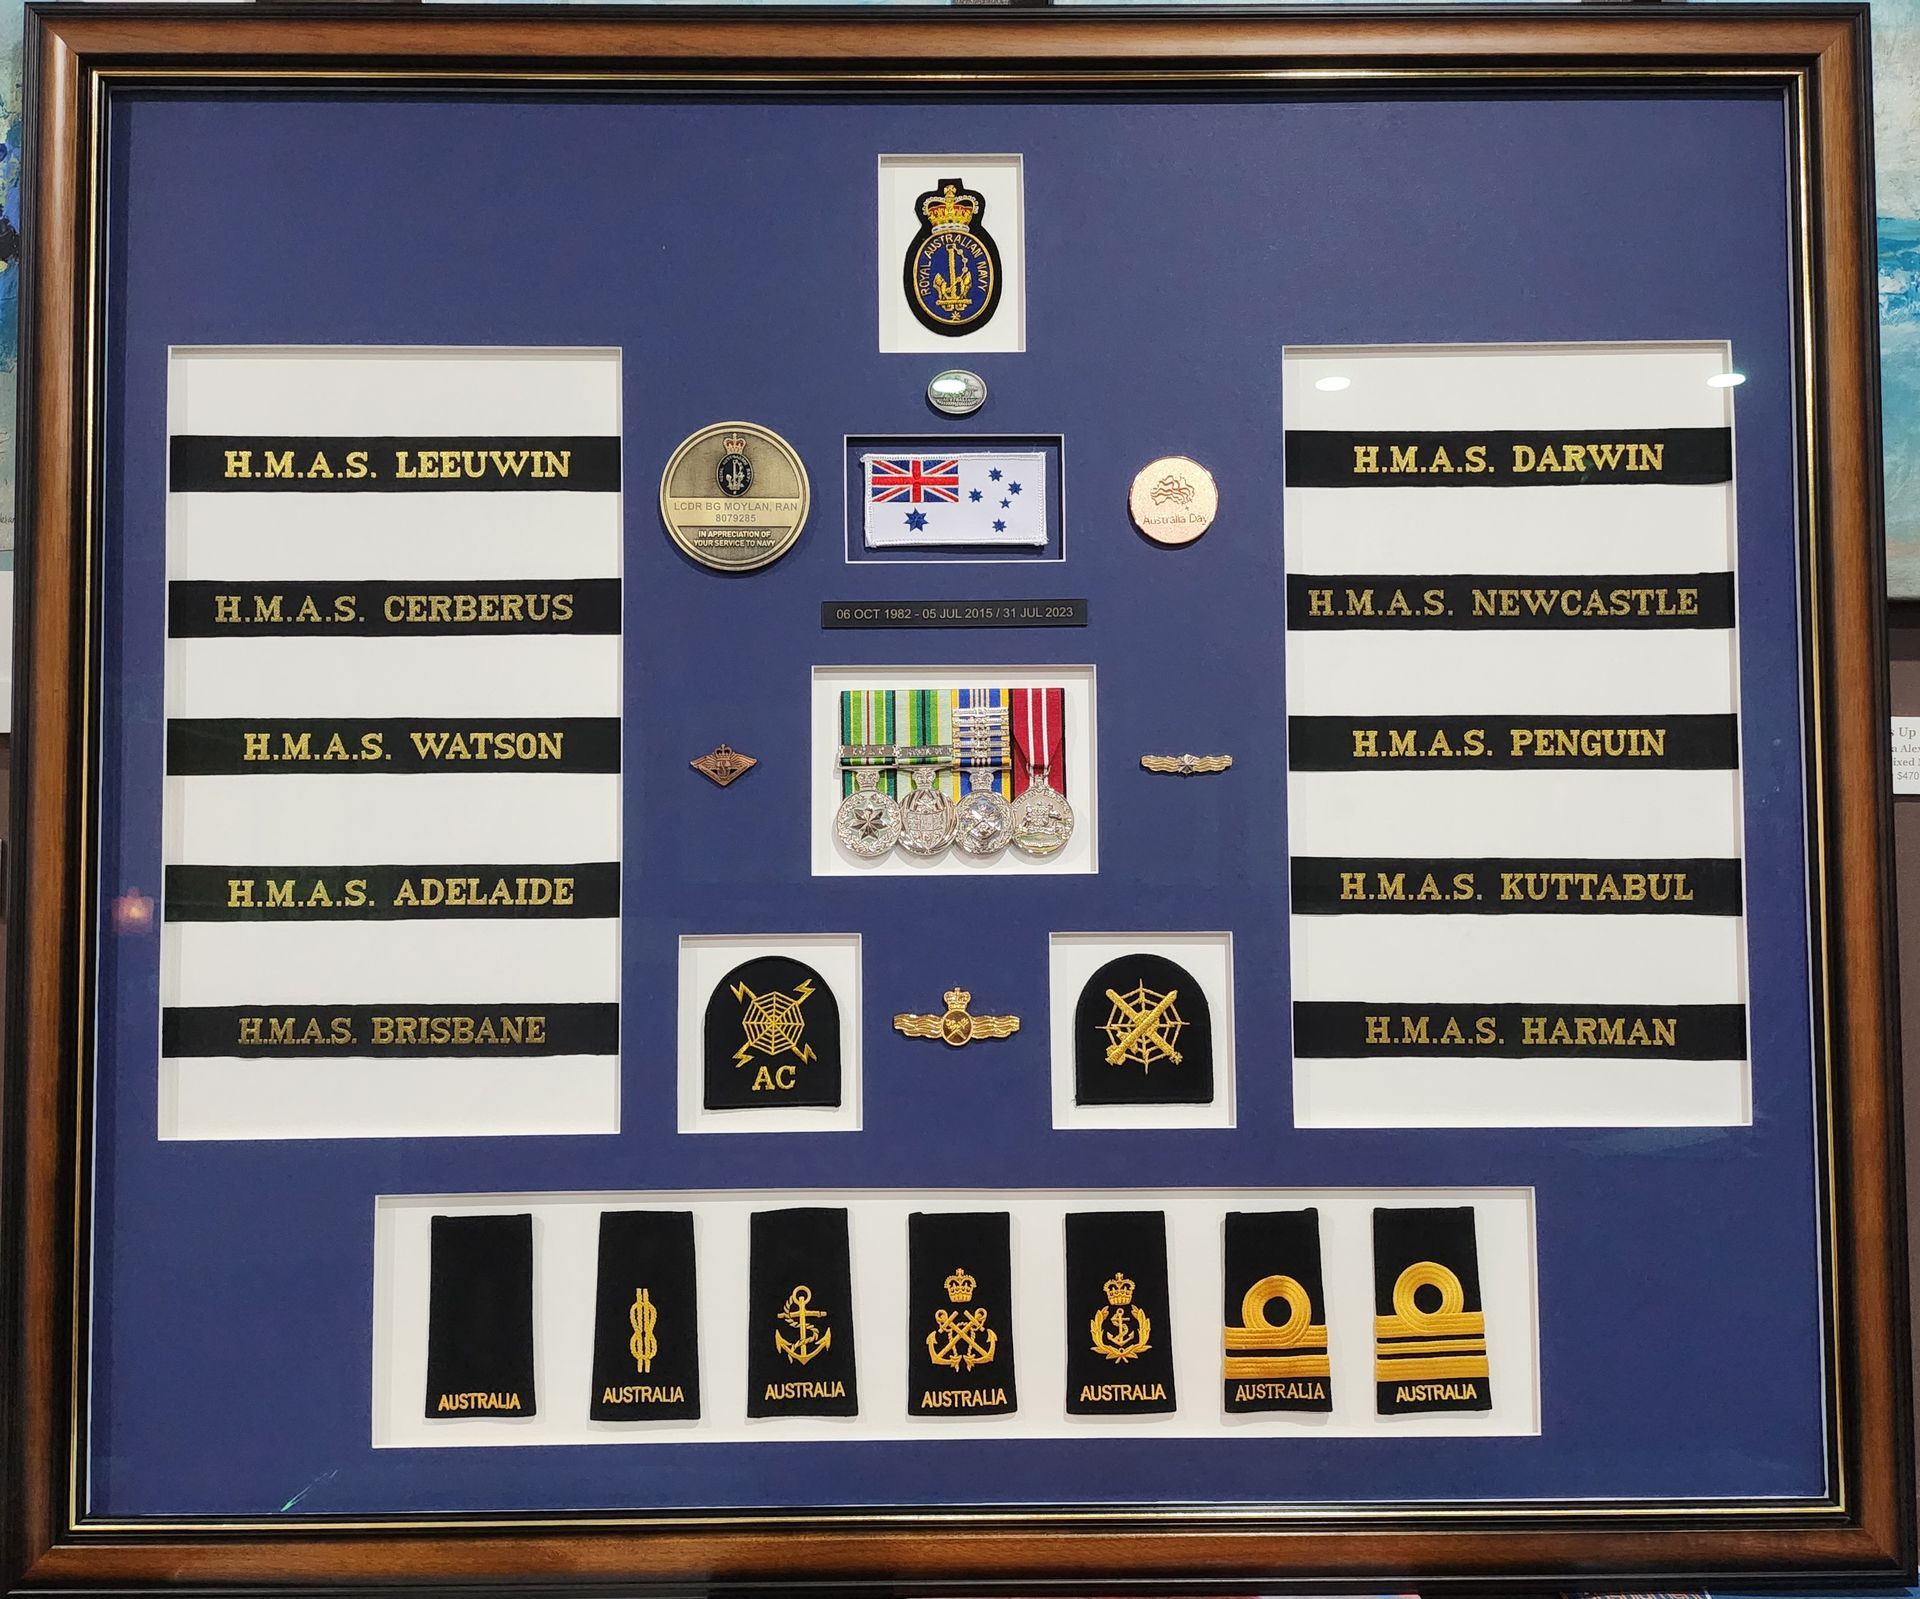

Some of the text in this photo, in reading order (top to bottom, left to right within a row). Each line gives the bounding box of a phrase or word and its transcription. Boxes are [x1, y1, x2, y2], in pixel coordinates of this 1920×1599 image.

[920, 234, 991, 297] ROYAL AUSTRALIAN NAVY
[224, 450, 571, 479] H.M.A.S. LEEUWIN
[1354, 444, 1664, 473] H.M.A.S. DARWIN
[674, 502, 797, 512] LCDR BG MOYLAN, RAN
[715, 514, 756, 523] 8079285
[1143, 513, 1207, 525] Australia Day
[698, 530, 771, 538] IN APPRECIATION OF
[757, 539, 775, 547] NAVY
[215, 594, 573, 622] H.M.A.S. CERBERUS
[1308, 589, 1698, 616] H.M.A.S. NEWCASTLE
[836, 609, 851, 619] 06
[854, 609, 880, 619] OCT
[885, 609, 912, 619] 1982
[922, 609, 937, 619] 05
[940, 608, 962, 619] JUL
[964, 608, 993, 618] 2015
[1003, 608, 1016, 618] 31
[1020, 608, 1043, 618] JUL
[1045, 607, 1074, 617] 2023
[1899, 727, 1917, 739] Up
[244, 732, 563, 761] H.M.A.S. WATSON
[1352, 729, 1666, 758] H.M.A.S. PENGUIN
[1893, 757, 1915, 767] ixed
[1897, 771, 1920, 780] $470
[227, 878, 574, 907] H.M.A.S. ADELAIDE
[1341, 872, 1694, 901] H.M.A.S. KUTTABUL
[238, 1017, 545, 1045] H.M.A.S. BRISBANE
[1365, 1016, 1677, 1046] H.M.A.S. HARMAN
[752, 1065, 796, 1091] AC
[603, 1386, 685, 1404] AUSTRALIA
[765, 1381, 845, 1400] AUSTRALIA
[921, 1388, 1007, 1408] AUSTRALIA
[1080, 1383, 1167, 1402] AUSTRALIA
[1235, 1383, 1325, 1402] AUSTRALIA
[1396, 1383, 1477, 1402] AUSTRALIA
[438, 1392, 521, 1411] AUSTRALIA
